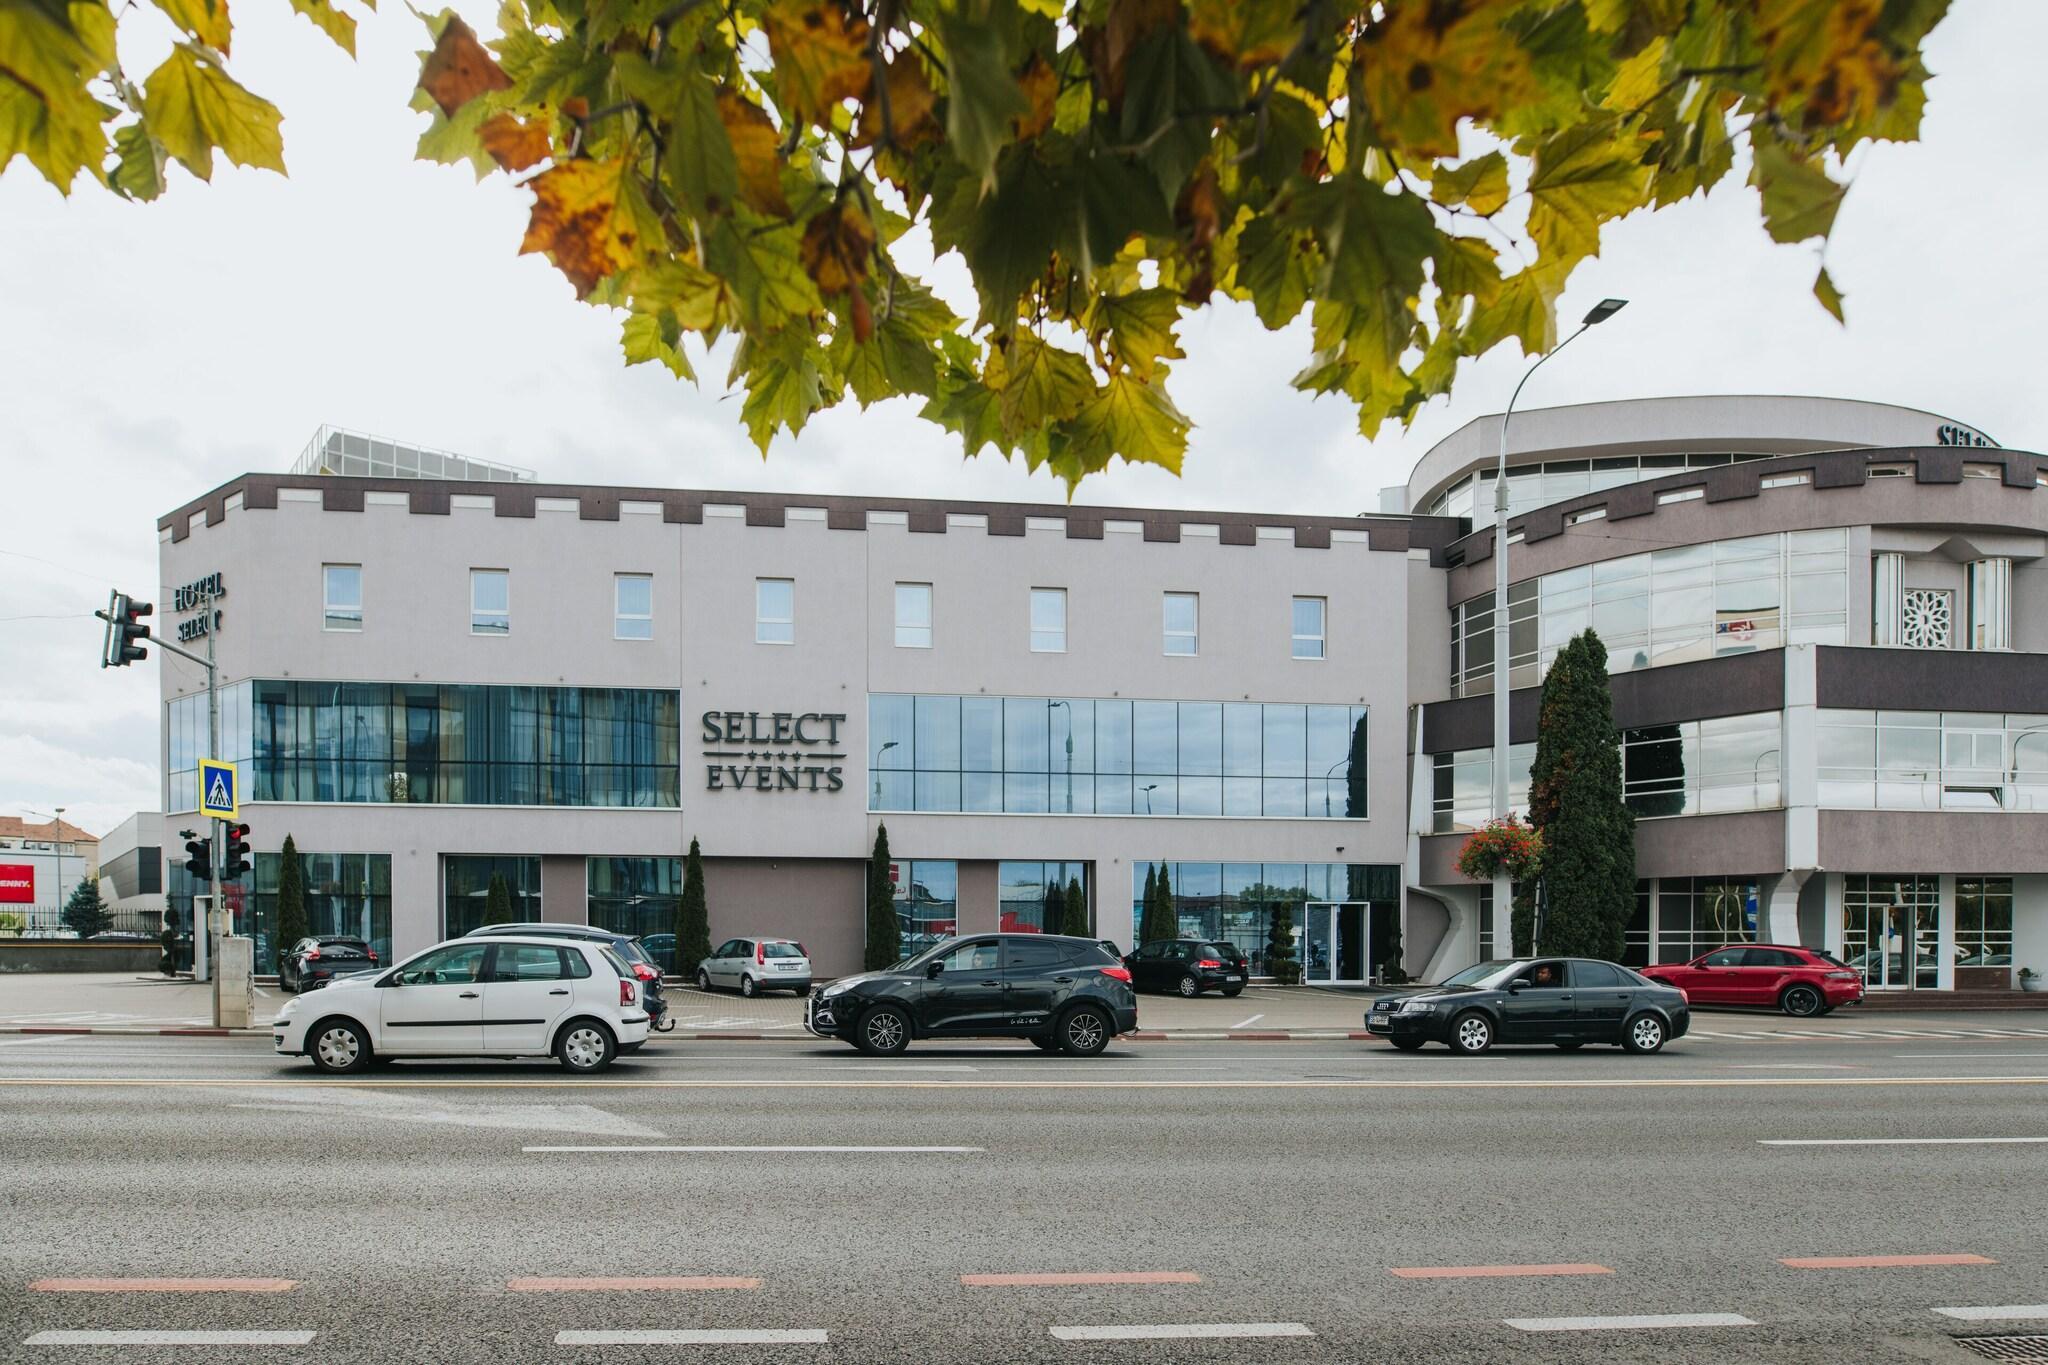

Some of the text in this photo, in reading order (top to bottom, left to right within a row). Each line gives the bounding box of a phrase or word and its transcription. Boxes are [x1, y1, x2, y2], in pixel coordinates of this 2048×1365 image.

[174, 572, 226, 611] HOTEL
[702, 711, 846, 744] SELECT
[706, 765, 844, 791] EVENTS
